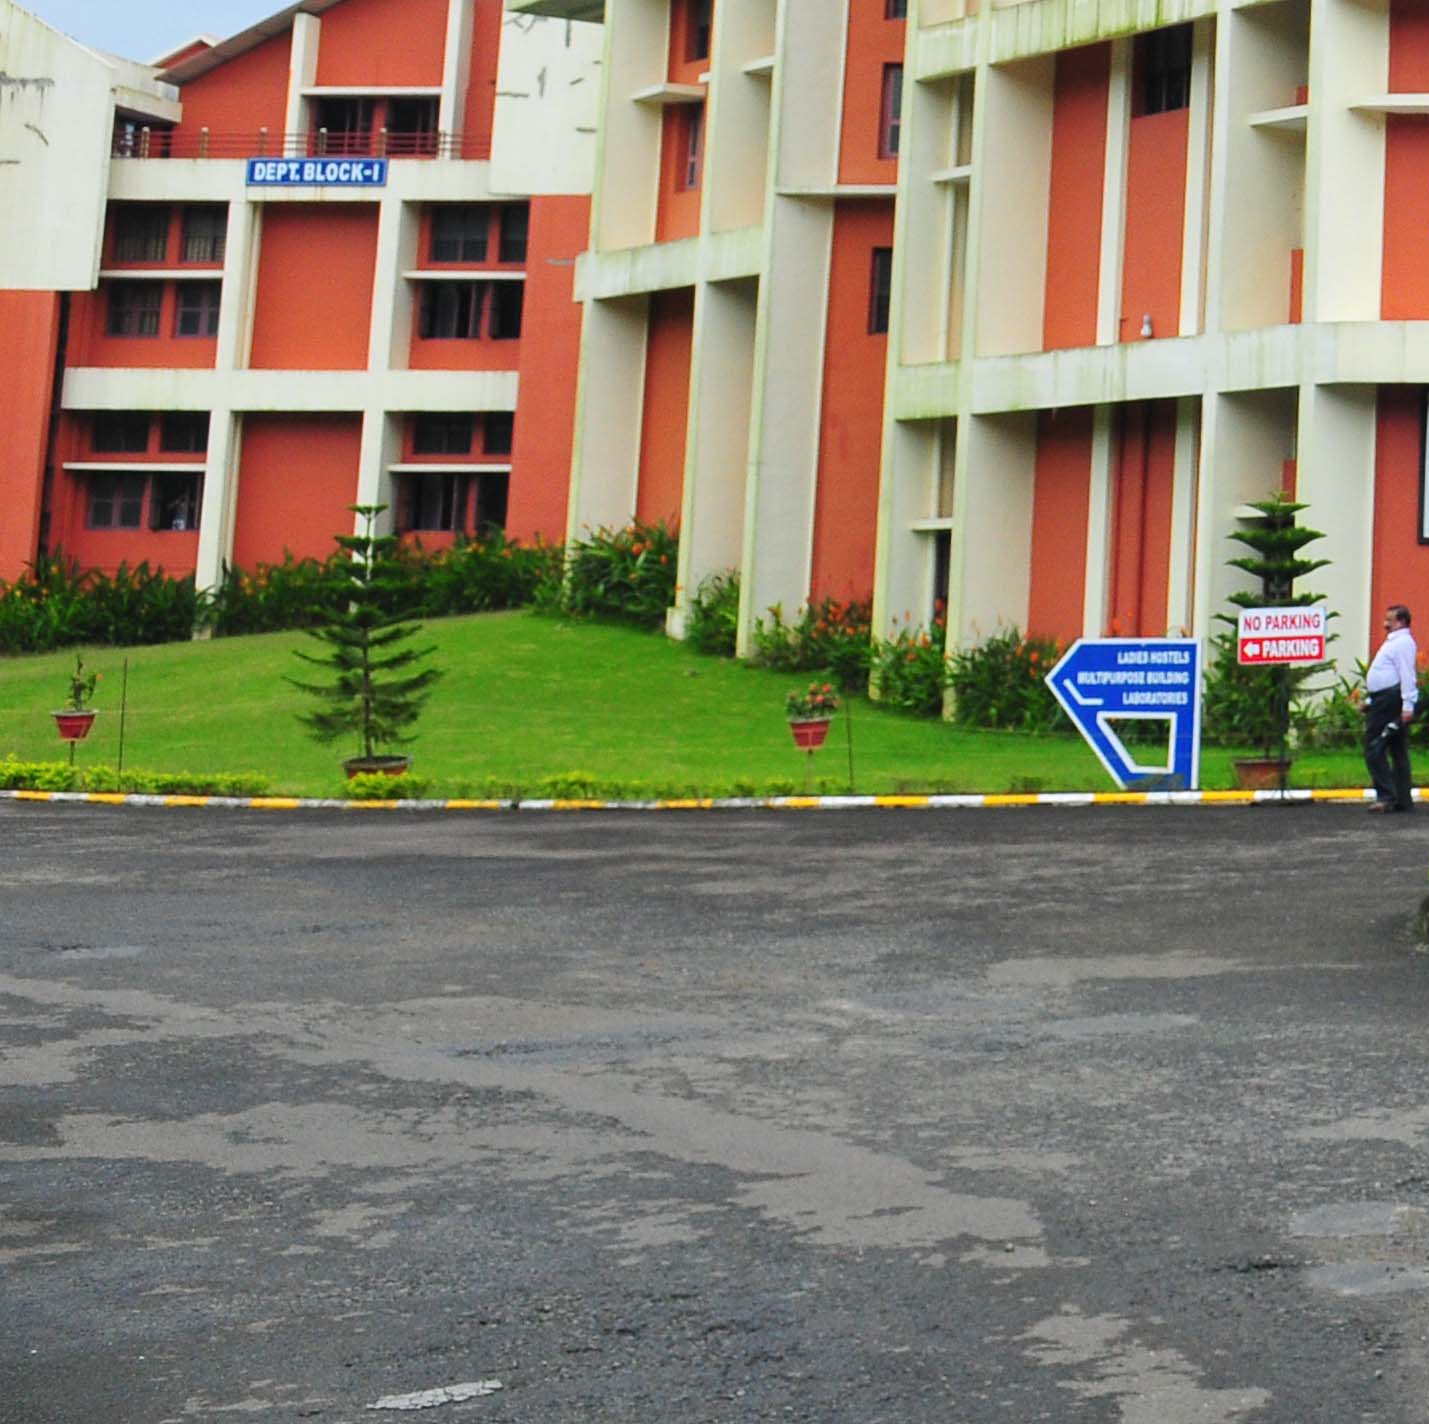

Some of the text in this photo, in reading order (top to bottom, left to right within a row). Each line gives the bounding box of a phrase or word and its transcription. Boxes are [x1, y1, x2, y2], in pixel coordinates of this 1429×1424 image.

[254, 162, 300, 181] DEPT.
[1243, 613, 1321, 631] NO PARKING
[1262, 638, 1320, 658] PARKING
